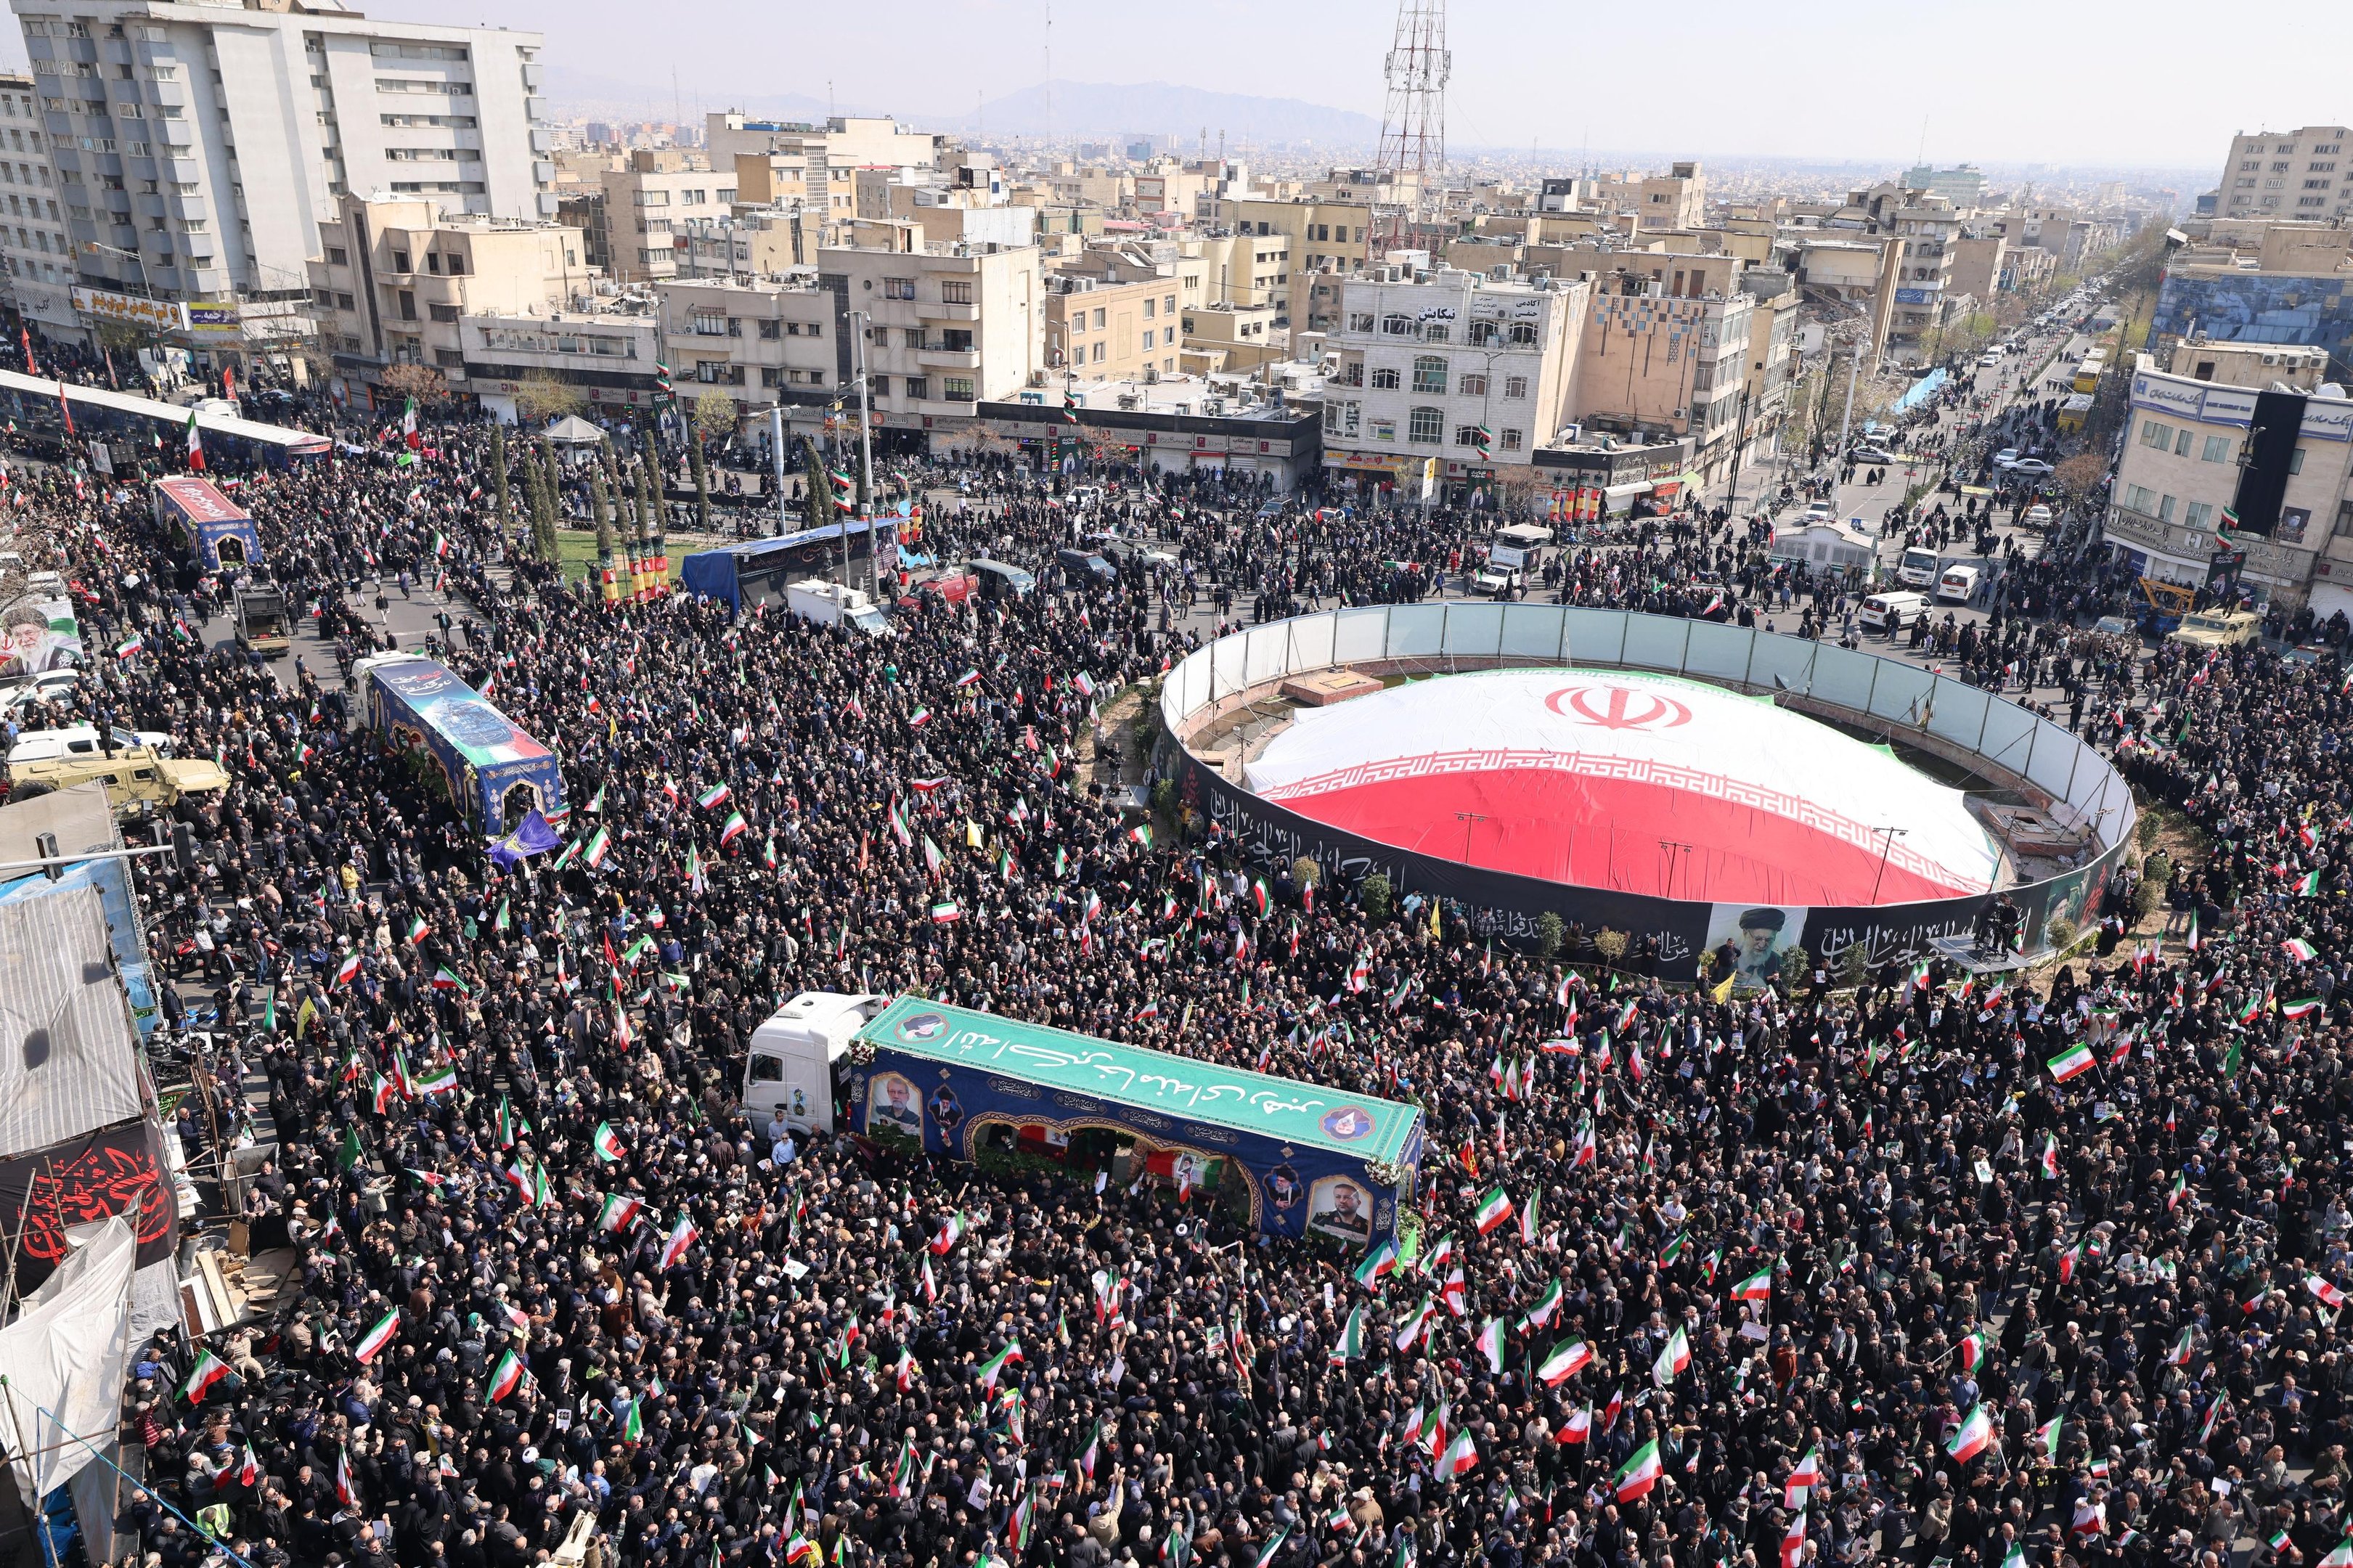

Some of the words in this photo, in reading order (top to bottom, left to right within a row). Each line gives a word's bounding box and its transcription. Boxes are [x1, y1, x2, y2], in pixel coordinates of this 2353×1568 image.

[1516, 299, 1541, 308] آکادمی
[2149, 388, 2164, 399] ایران
[2164, 392, 2185, 402] صادرات
[2185, 392, 2203, 409] بانک
[2328, 413, 2353, 429] بانک
[135, 1010, 149, 1020] انصا
[942, 1029, 1001, 1055] الله
[992, 1040, 1114, 1067] اکبر
[1250, 1091, 1325, 1115] رهبر
